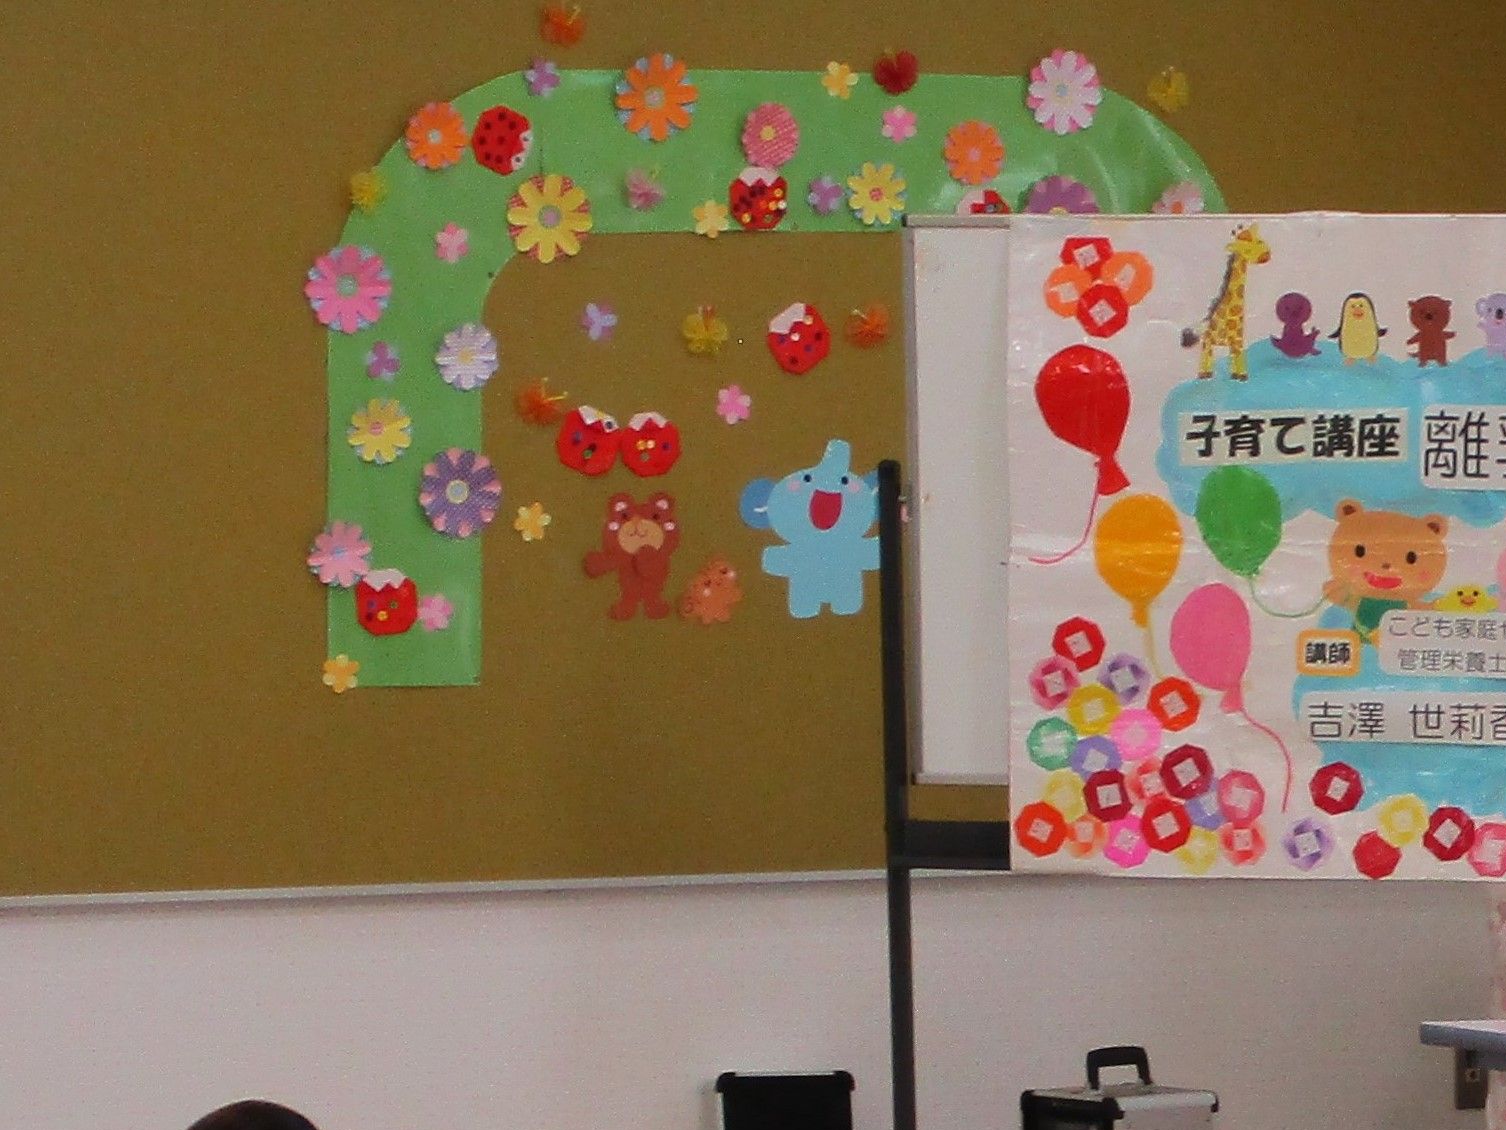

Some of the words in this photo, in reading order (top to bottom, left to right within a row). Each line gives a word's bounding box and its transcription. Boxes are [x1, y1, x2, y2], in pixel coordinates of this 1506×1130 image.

[1186, 414, 1400, 458] 子育て講座
[1305, 641, 1351, 665] 講師
[1307, 700, 1386, 739] 吉澤
